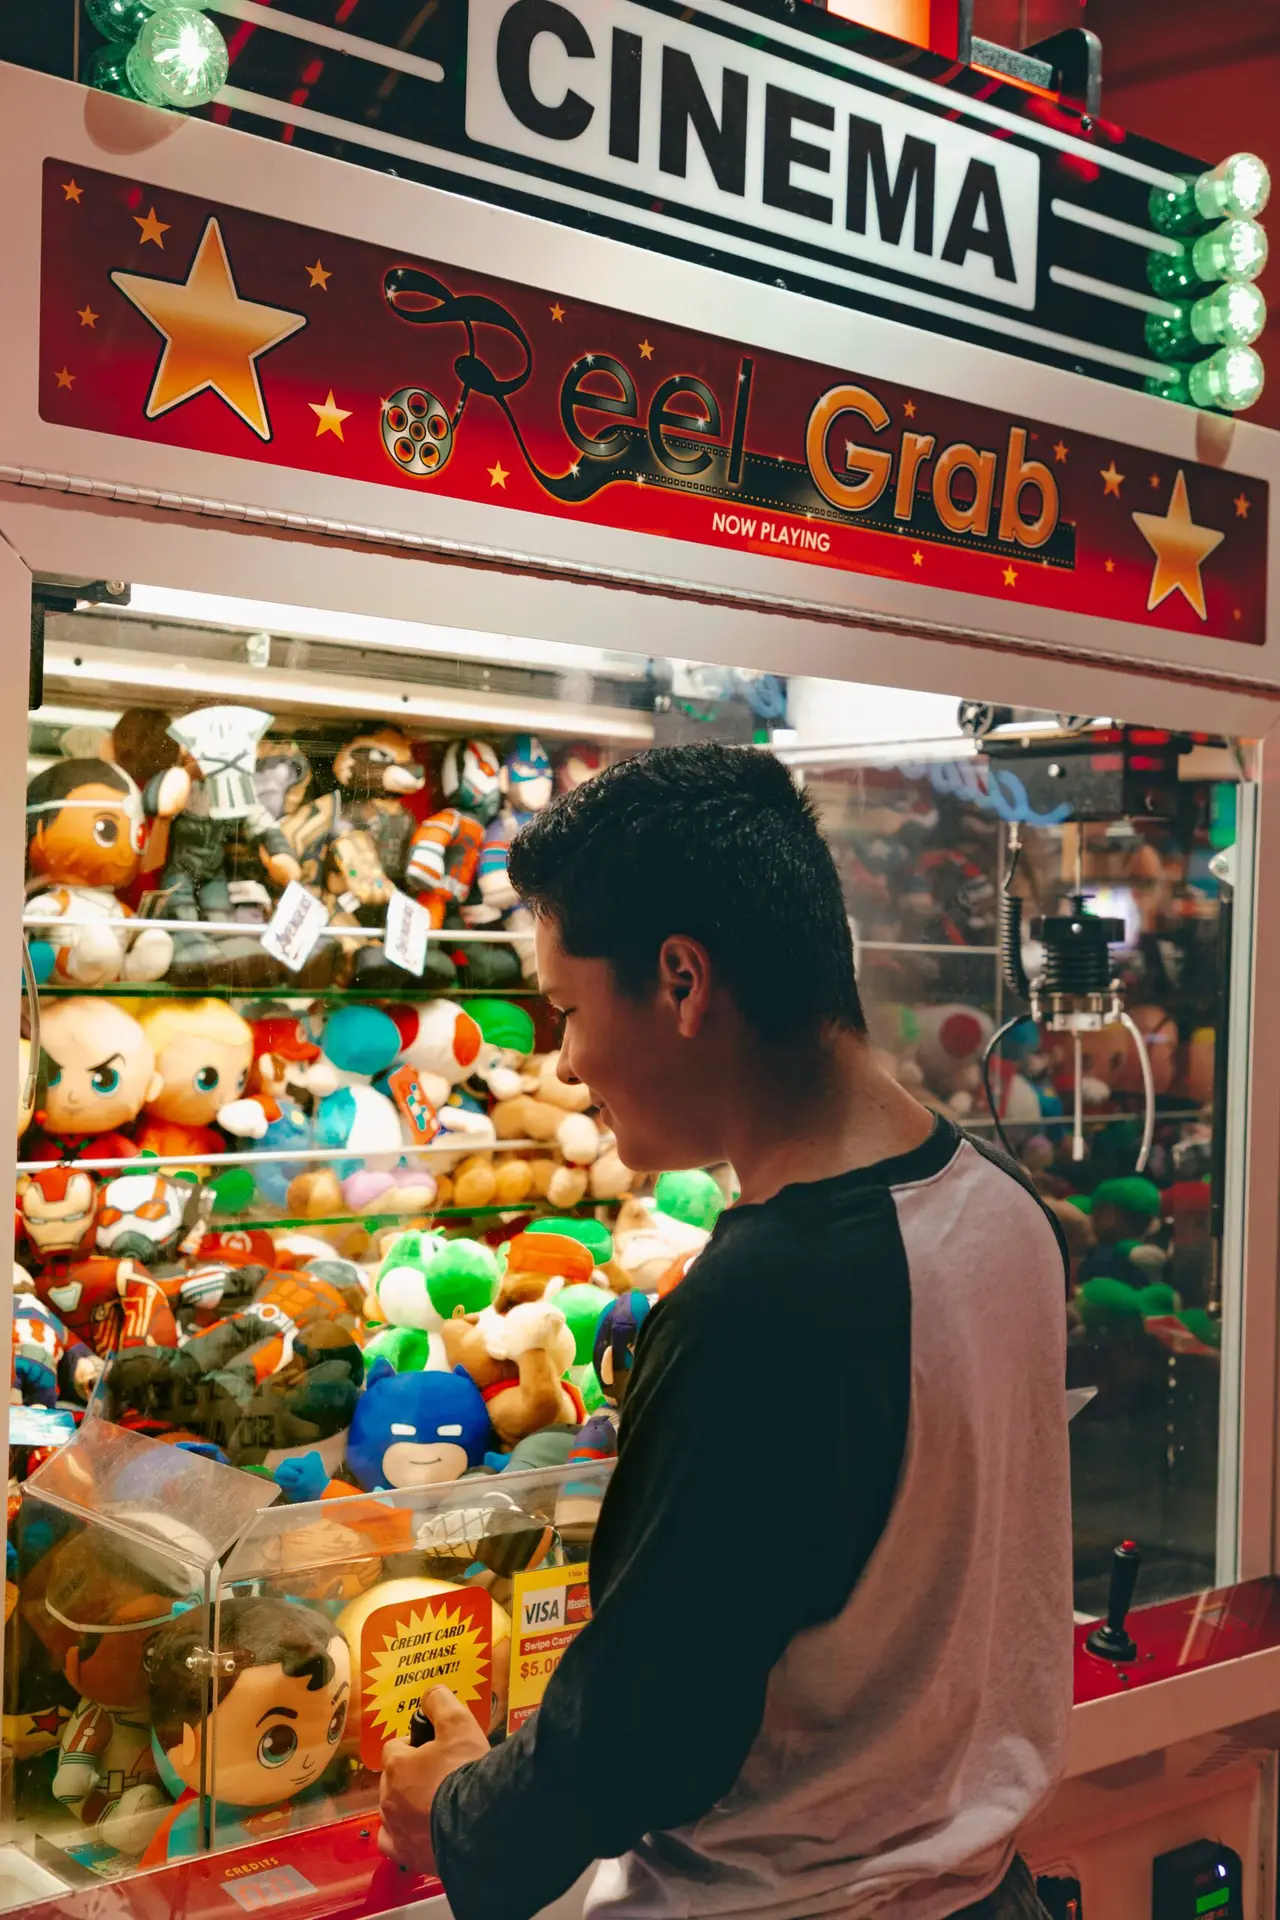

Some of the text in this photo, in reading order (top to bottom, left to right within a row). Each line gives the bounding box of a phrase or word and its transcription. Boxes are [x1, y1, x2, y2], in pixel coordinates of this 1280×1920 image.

[497, 0, 1017, 284] CINEMA
[383, 267, 1059, 548] Reel Grab
[712, 512, 831, 552] NOW PLAYING
[524, 1599, 560, 1625] VISA
[390, 1624, 466, 1652] CREDIT CARD
[524, 1639, 550, 1651] Swipe
[397, 1643, 458, 1669] PURCHASE
[394, 1661, 461, 1687] DISCOUNT!!
[396, 1700, 406, 1713] 8
[224, 1856, 279, 1877] CREDITS
